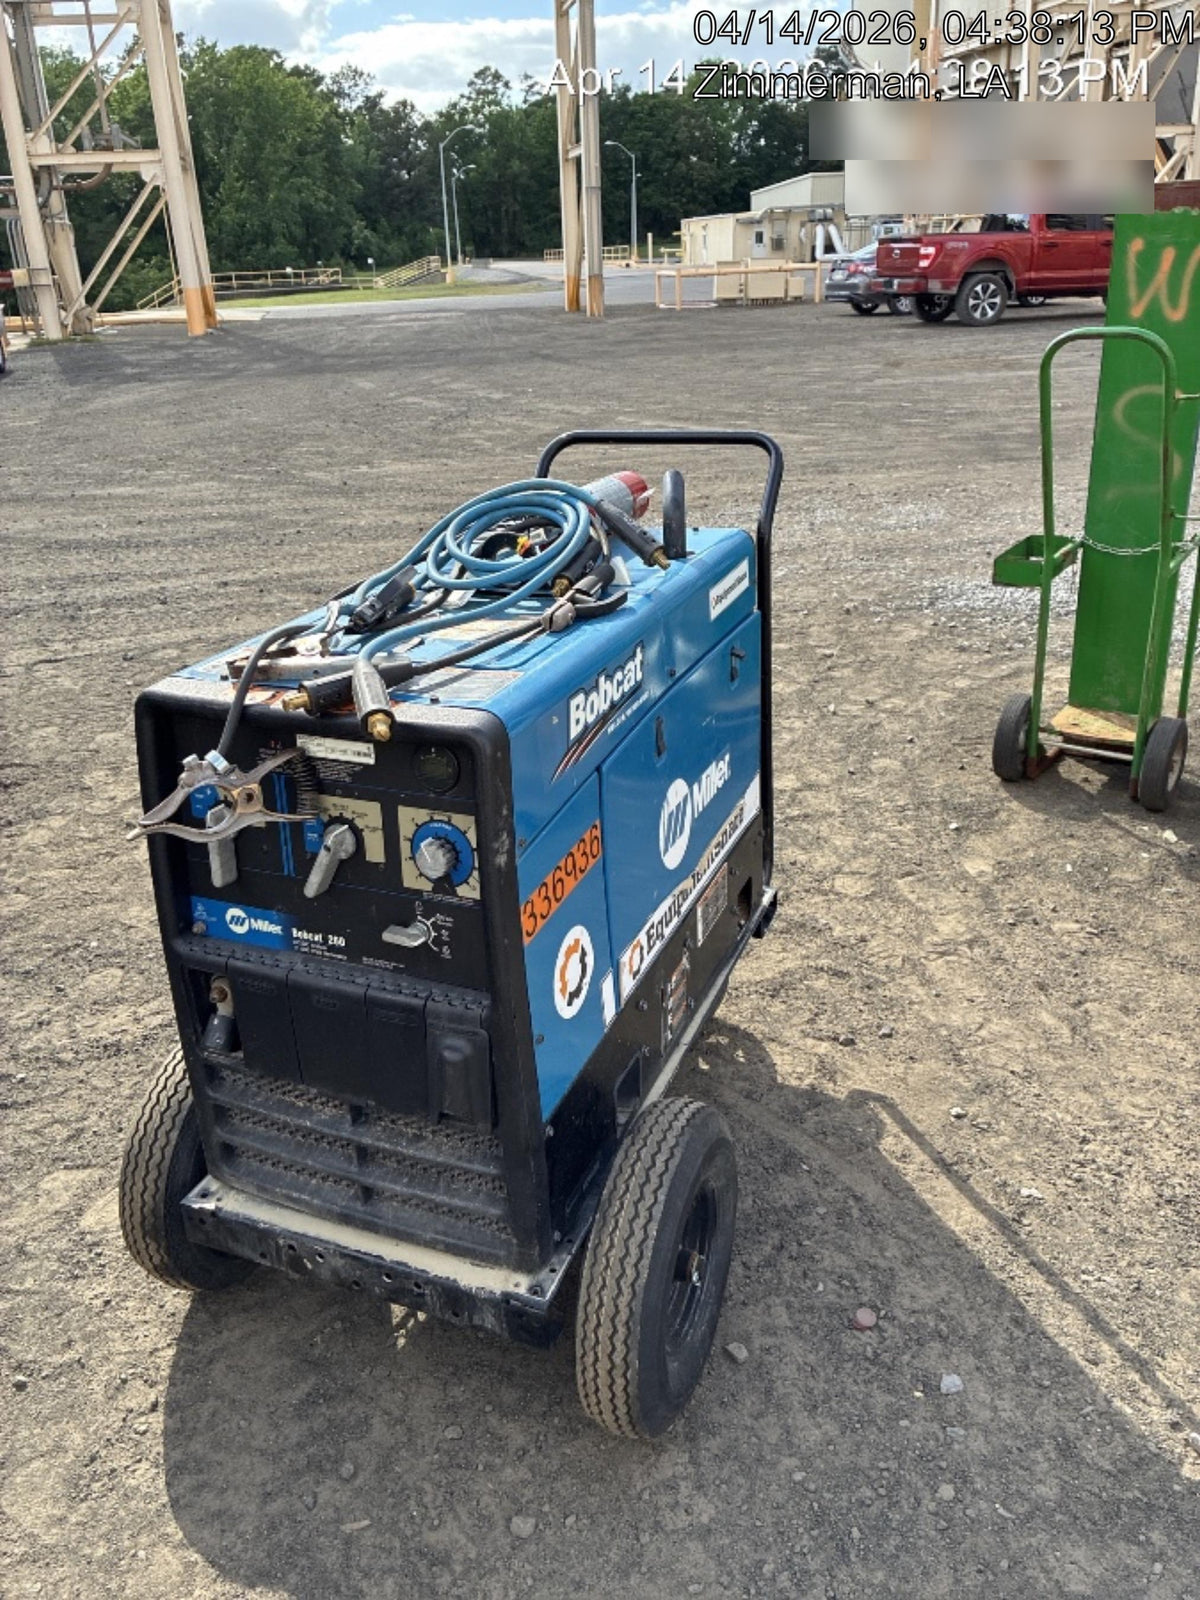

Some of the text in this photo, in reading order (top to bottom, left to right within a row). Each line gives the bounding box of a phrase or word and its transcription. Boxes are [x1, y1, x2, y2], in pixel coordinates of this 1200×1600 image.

[569, 645, 643, 743] Bobcat
[692, 753, 731, 818] Miller
[523, 824, 600, 938] 336936
